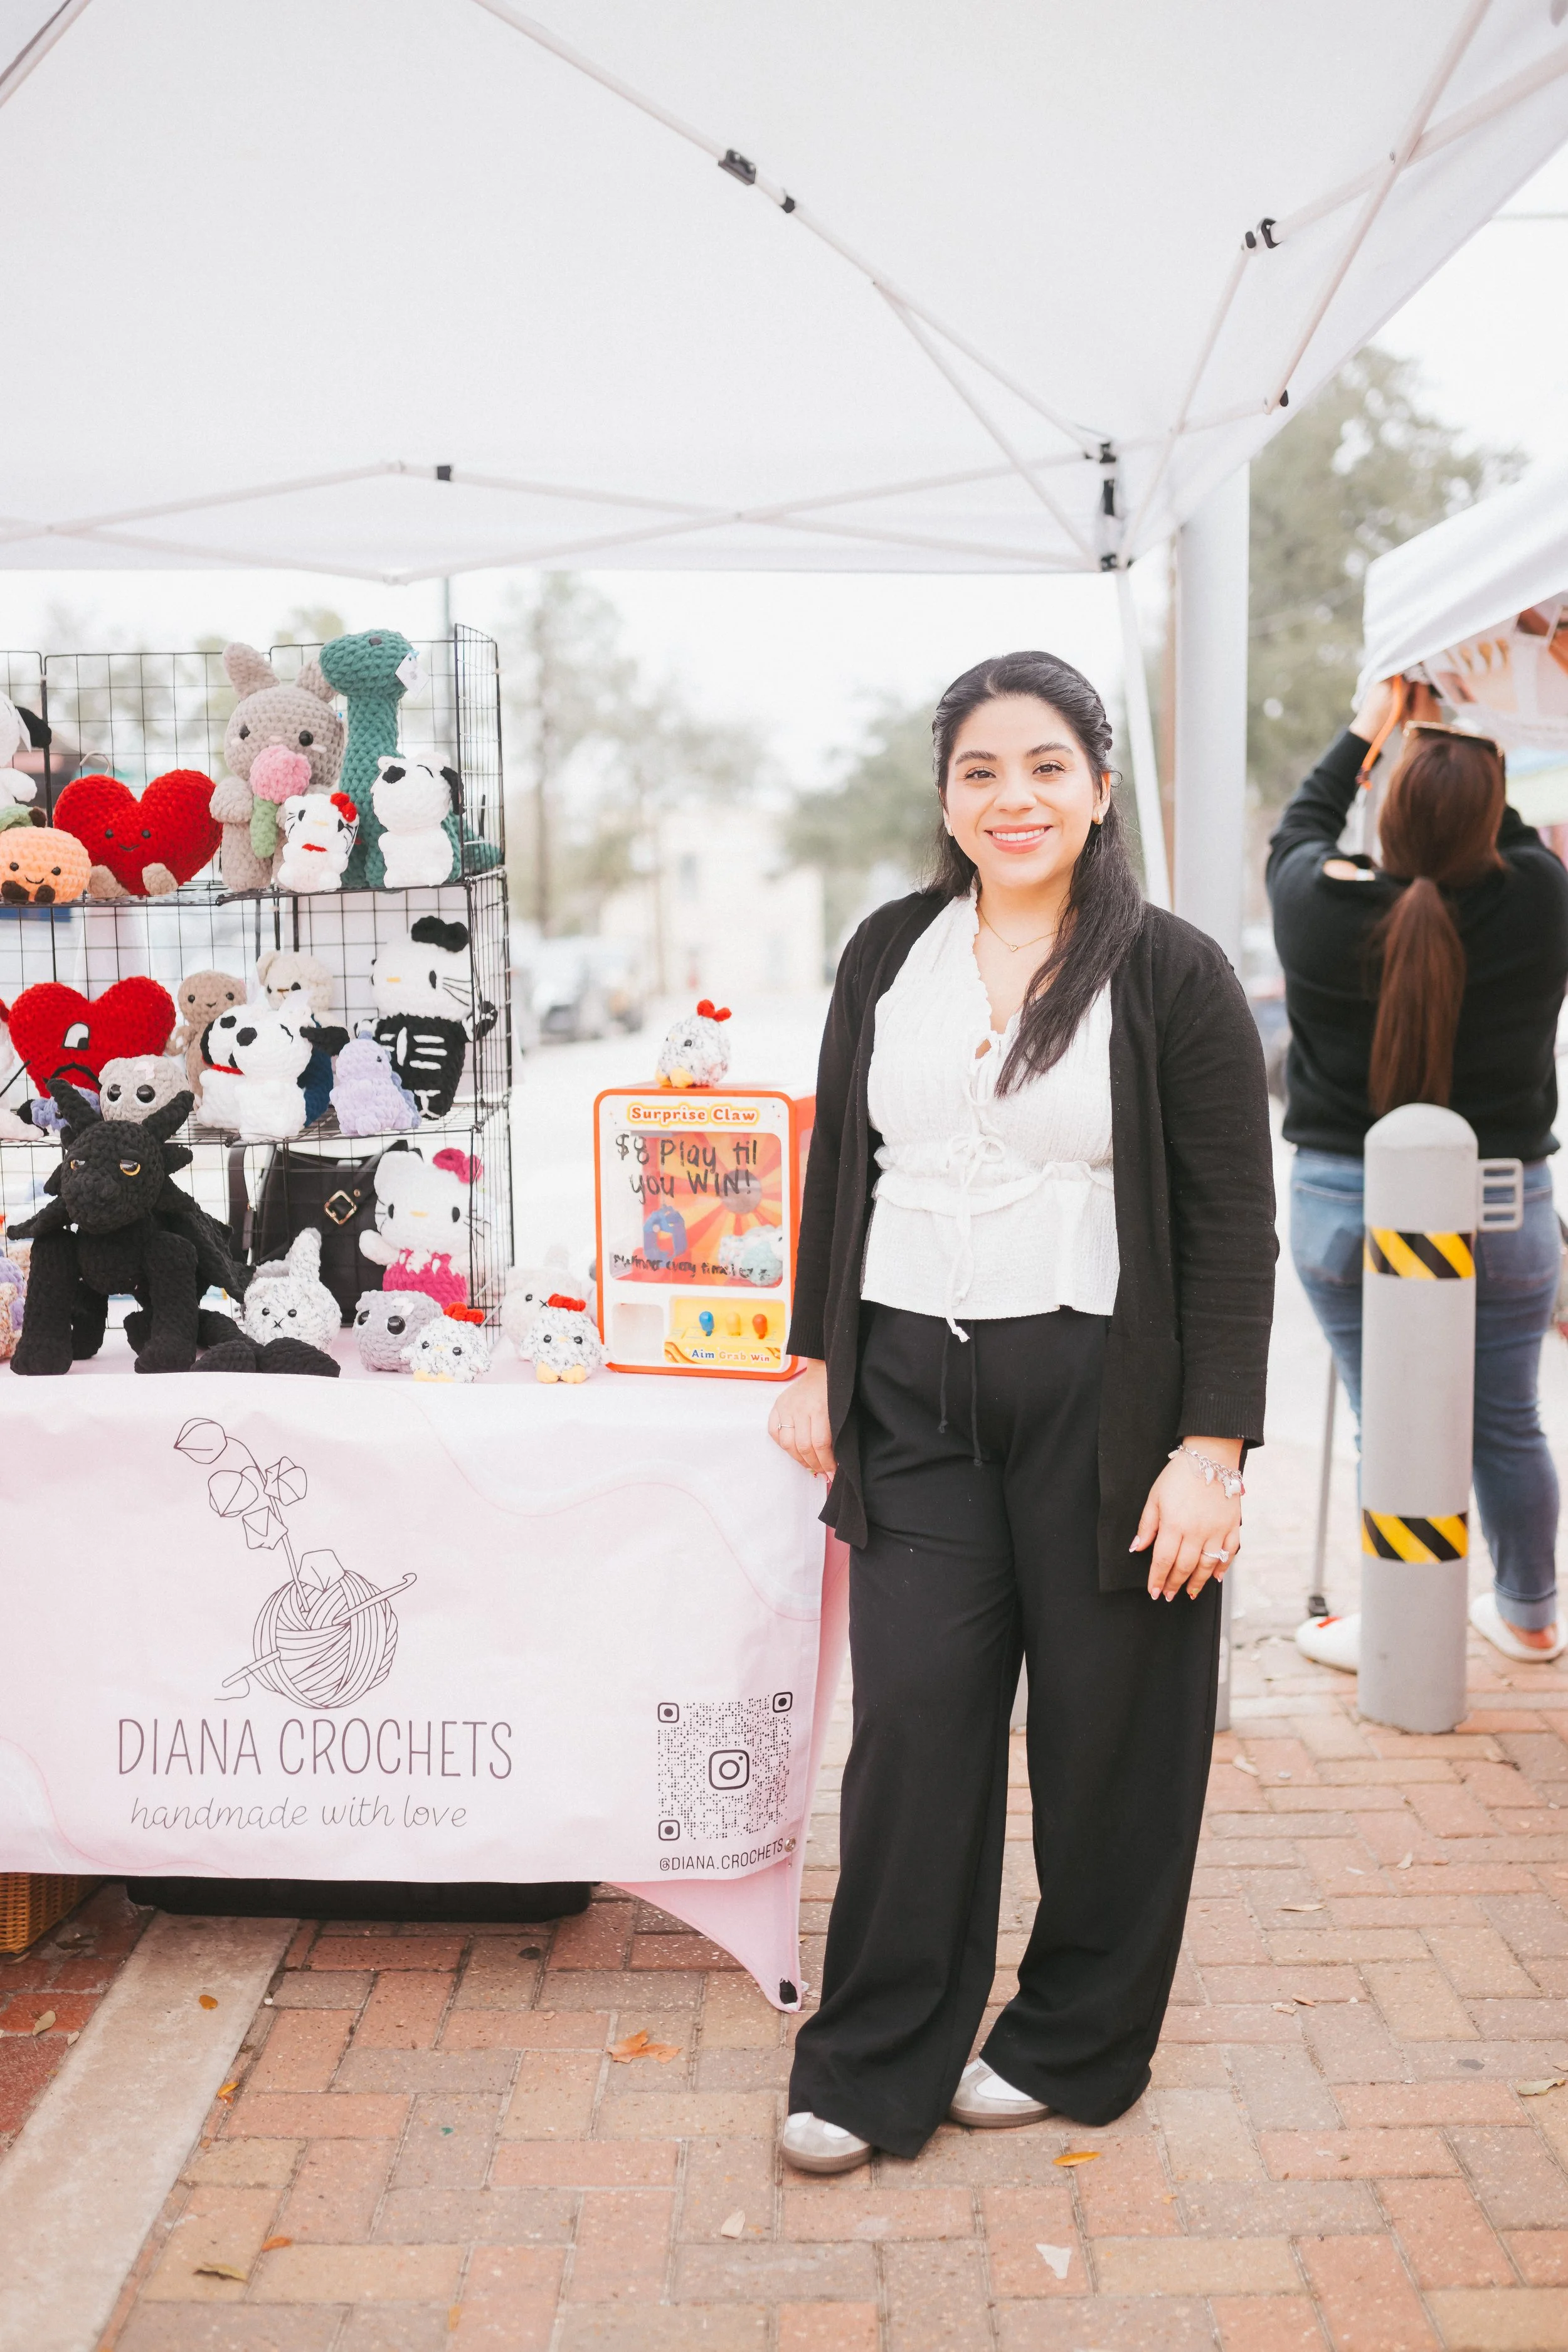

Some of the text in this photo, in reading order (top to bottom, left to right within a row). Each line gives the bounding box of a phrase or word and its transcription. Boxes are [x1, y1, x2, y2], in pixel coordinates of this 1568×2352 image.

[631, 1106, 756, 1123] Surprise Claw
[615, 1133, 758, 1174] $8 Play til
[629, 1173, 675, 1205] you
[692, 1349, 714, 1359] Aim
[719, 1351, 746, 1360] Grab
[118, 1718, 512, 1779] DIANA CROCHETS
[130, 1794, 467, 1830] handmade with love
[659, 1837, 783, 1872] @DIANA.CROCHETS
